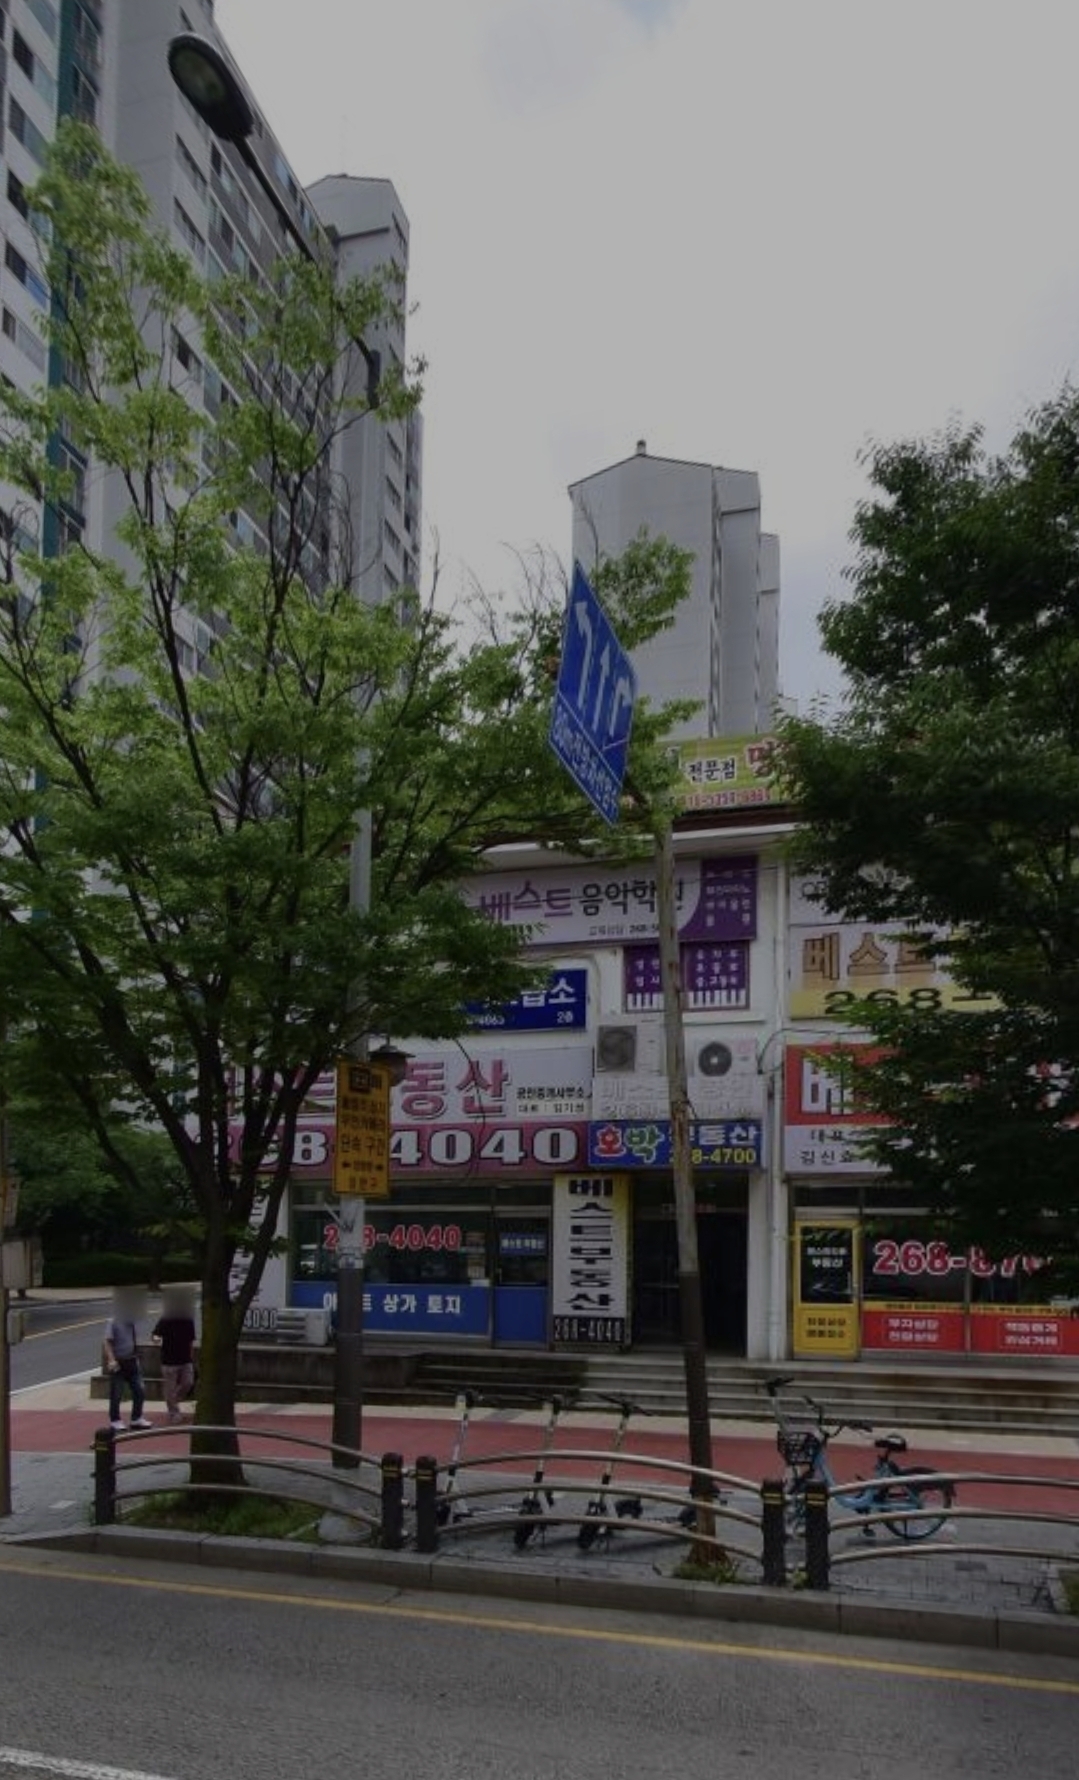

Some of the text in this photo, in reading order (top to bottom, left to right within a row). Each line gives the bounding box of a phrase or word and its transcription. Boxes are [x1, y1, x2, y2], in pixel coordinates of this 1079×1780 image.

[688, 758, 735, 782] 전문점
[479, 876, 683, 920] 베스트 음악학
[802, 932, 937, 982] 베스트
[594, 1123, 666, 1165] 호박
[668, 1148, 757, 1165] 8-4700
[566, 1179, 615, 1311] 베스트부동산
[383, 1293, 418, 1315] 상가
[426, 1294, 462, 1316] 토지
[554, 1317, 622, 1342] 268-4040
